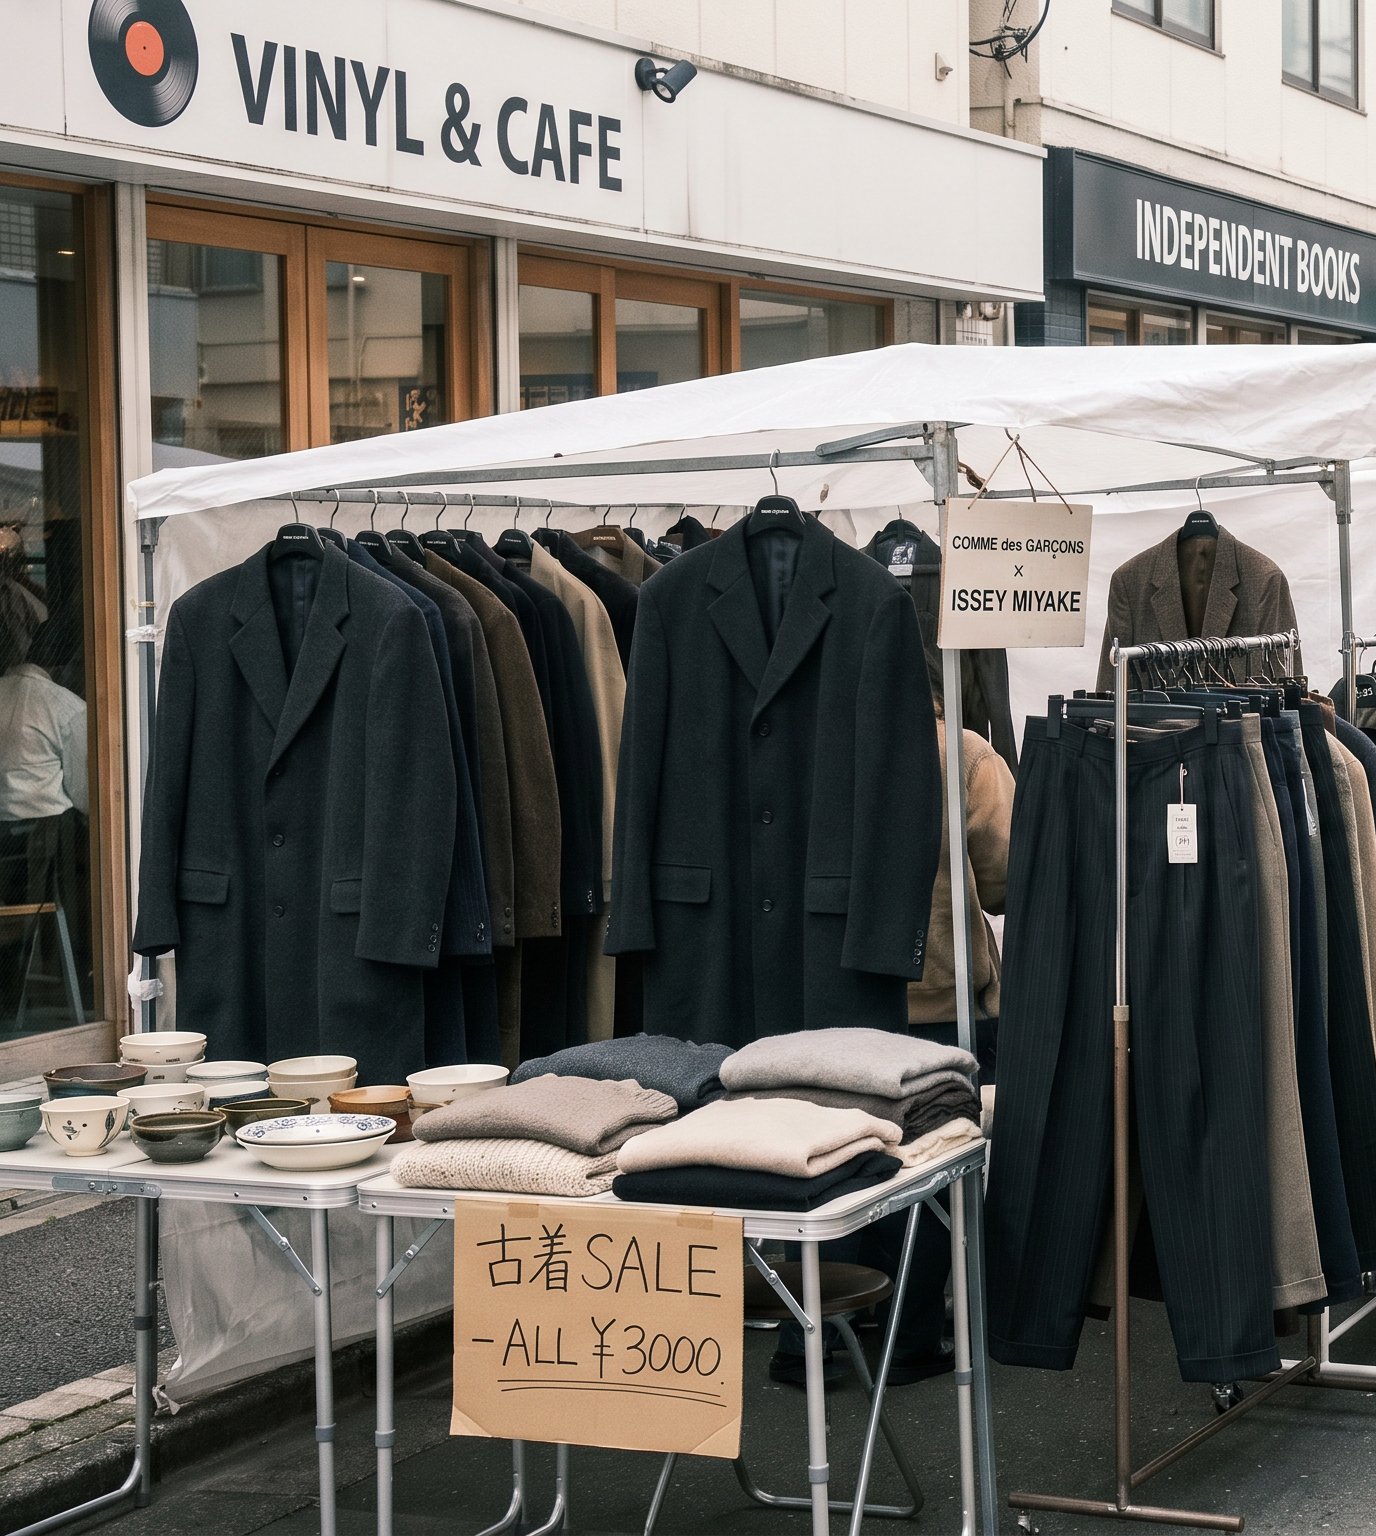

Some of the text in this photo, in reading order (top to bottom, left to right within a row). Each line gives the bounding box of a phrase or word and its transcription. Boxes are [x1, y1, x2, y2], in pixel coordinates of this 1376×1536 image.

[231, 33, 623, 192] VINYL & CAFE
[1136, 198, 1360, 305] INDEPENDENT BOOKS
[952, 535, 1084, 559] COMME des GARÇONS
[952, 589, 1081, 612] ISSEY MIYAKE
